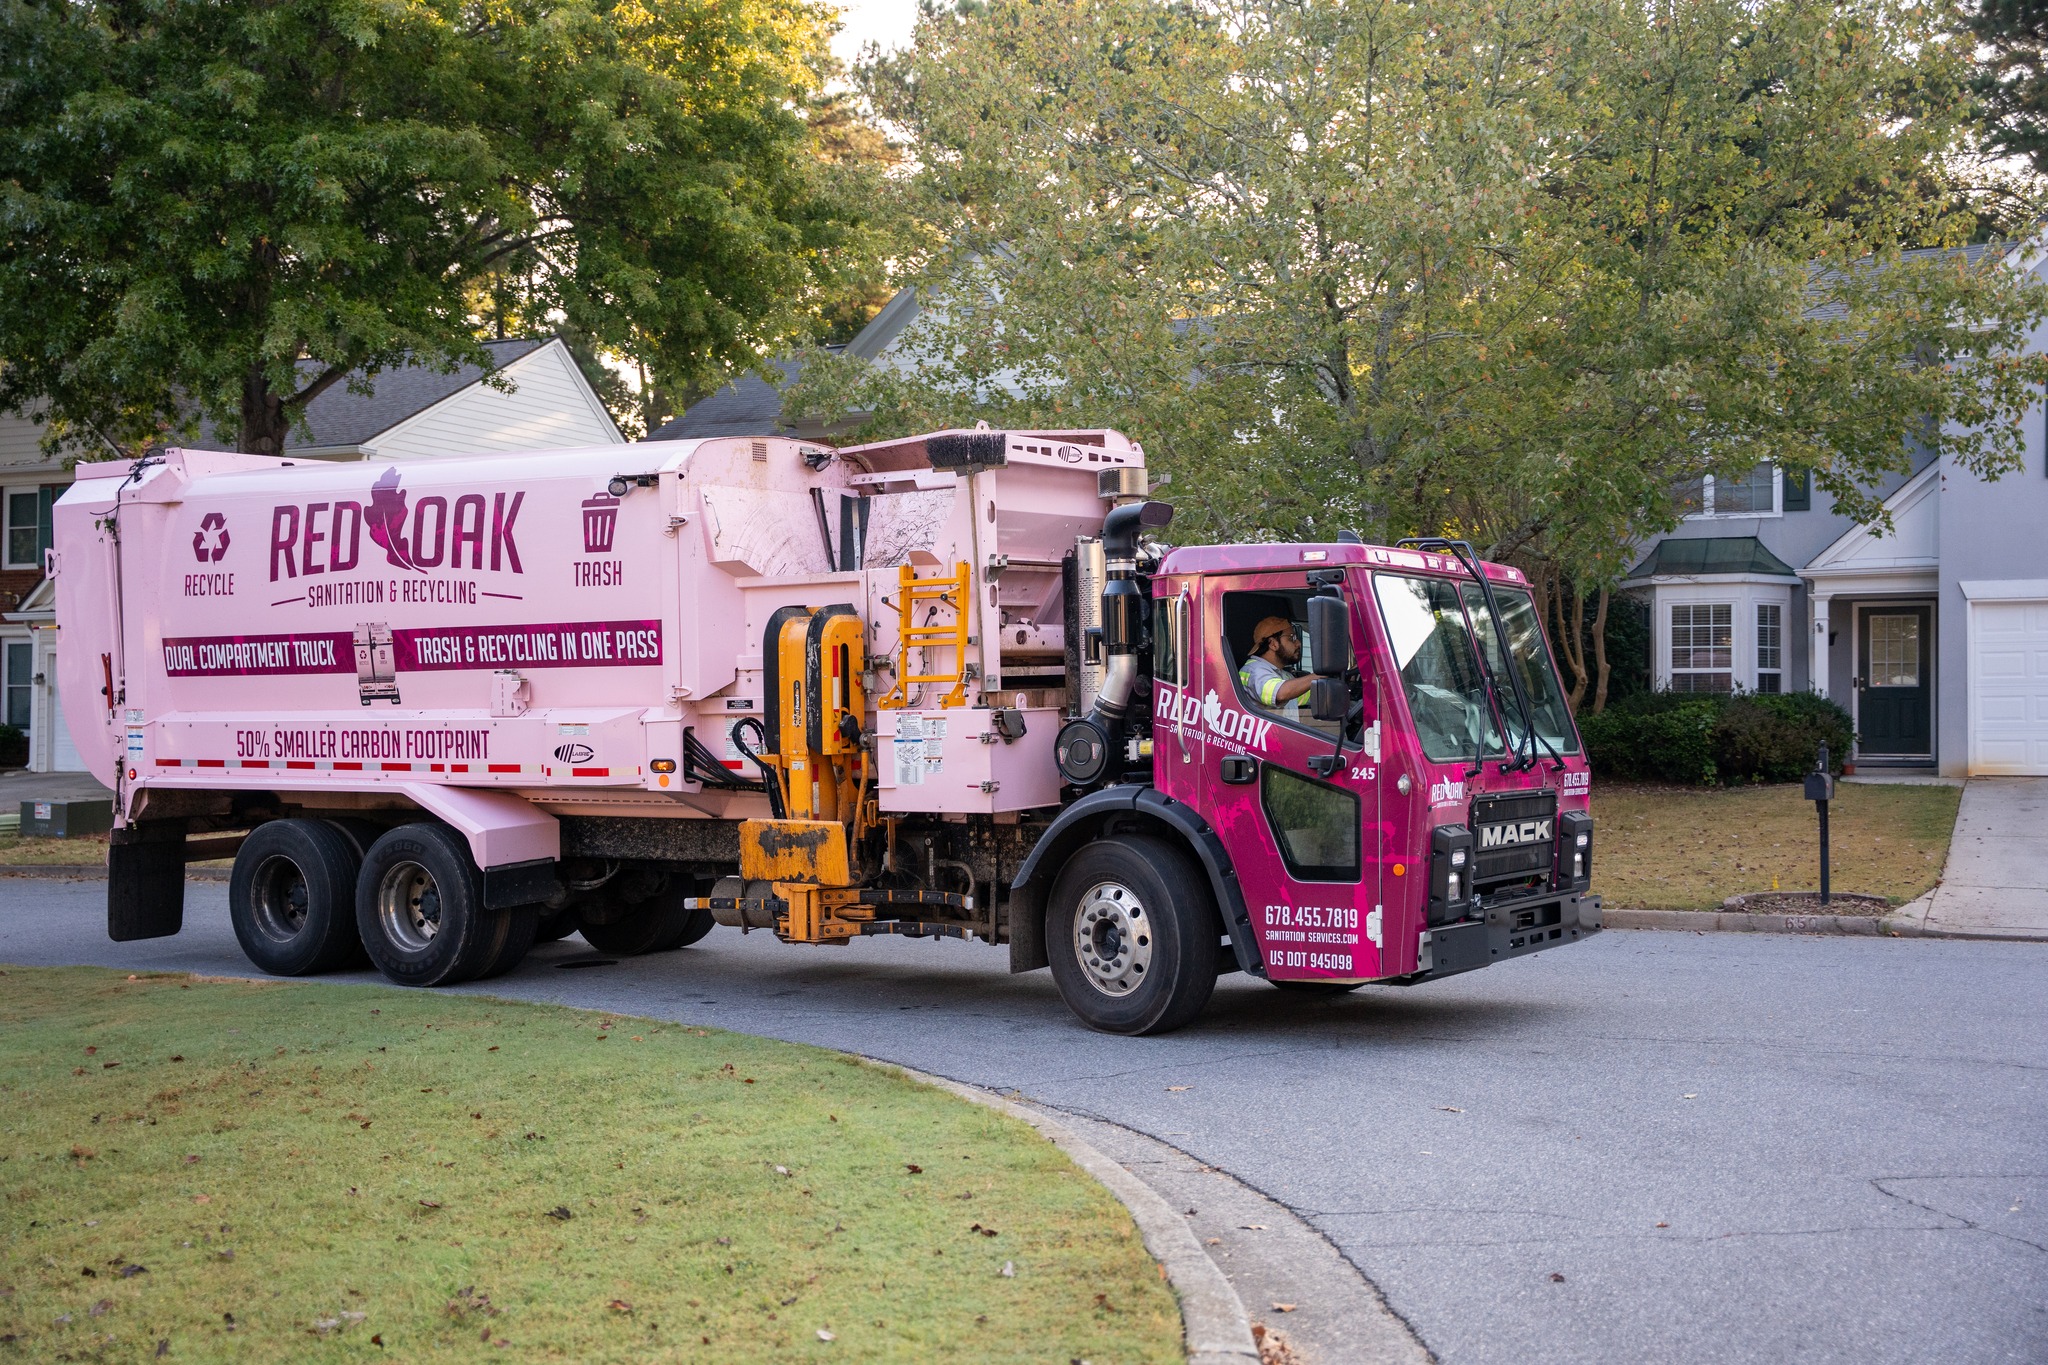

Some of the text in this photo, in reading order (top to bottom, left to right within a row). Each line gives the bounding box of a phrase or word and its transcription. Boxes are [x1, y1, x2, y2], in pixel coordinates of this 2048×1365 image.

[270, 491, 525, 582] RED OAK
[184, 573, 235, 597] RECYCLE
[573, 561, 622, 587] TRASH
[308, 580, 476, 608] SANITATION & RECYCLING
[165, 640, 337, 671] DUAL COMPARTMENT TRUCK
[414, 629, 659, 664] TRASH & RECYCLING IN ONE PASS
[1156, 688, 1273, 752] RED OAK
[237, 730, 489, 760] 50% SMALLER CARBON FOOTPRINT
[1169, 723, 1246, 756] SAITATION & RECYCLING
[1351, 766, 1376, 780] 245
[1431, 781, 1464, 803] RED OAK
[1482, 820, 1550, 848] MACK
[1265, 905, 1358, 929] 678.455.7819
[1265, 930, 1359, 945] SANITATION SERVICES.COM
[1270, 950, 1353, 971] US DOT 945098
